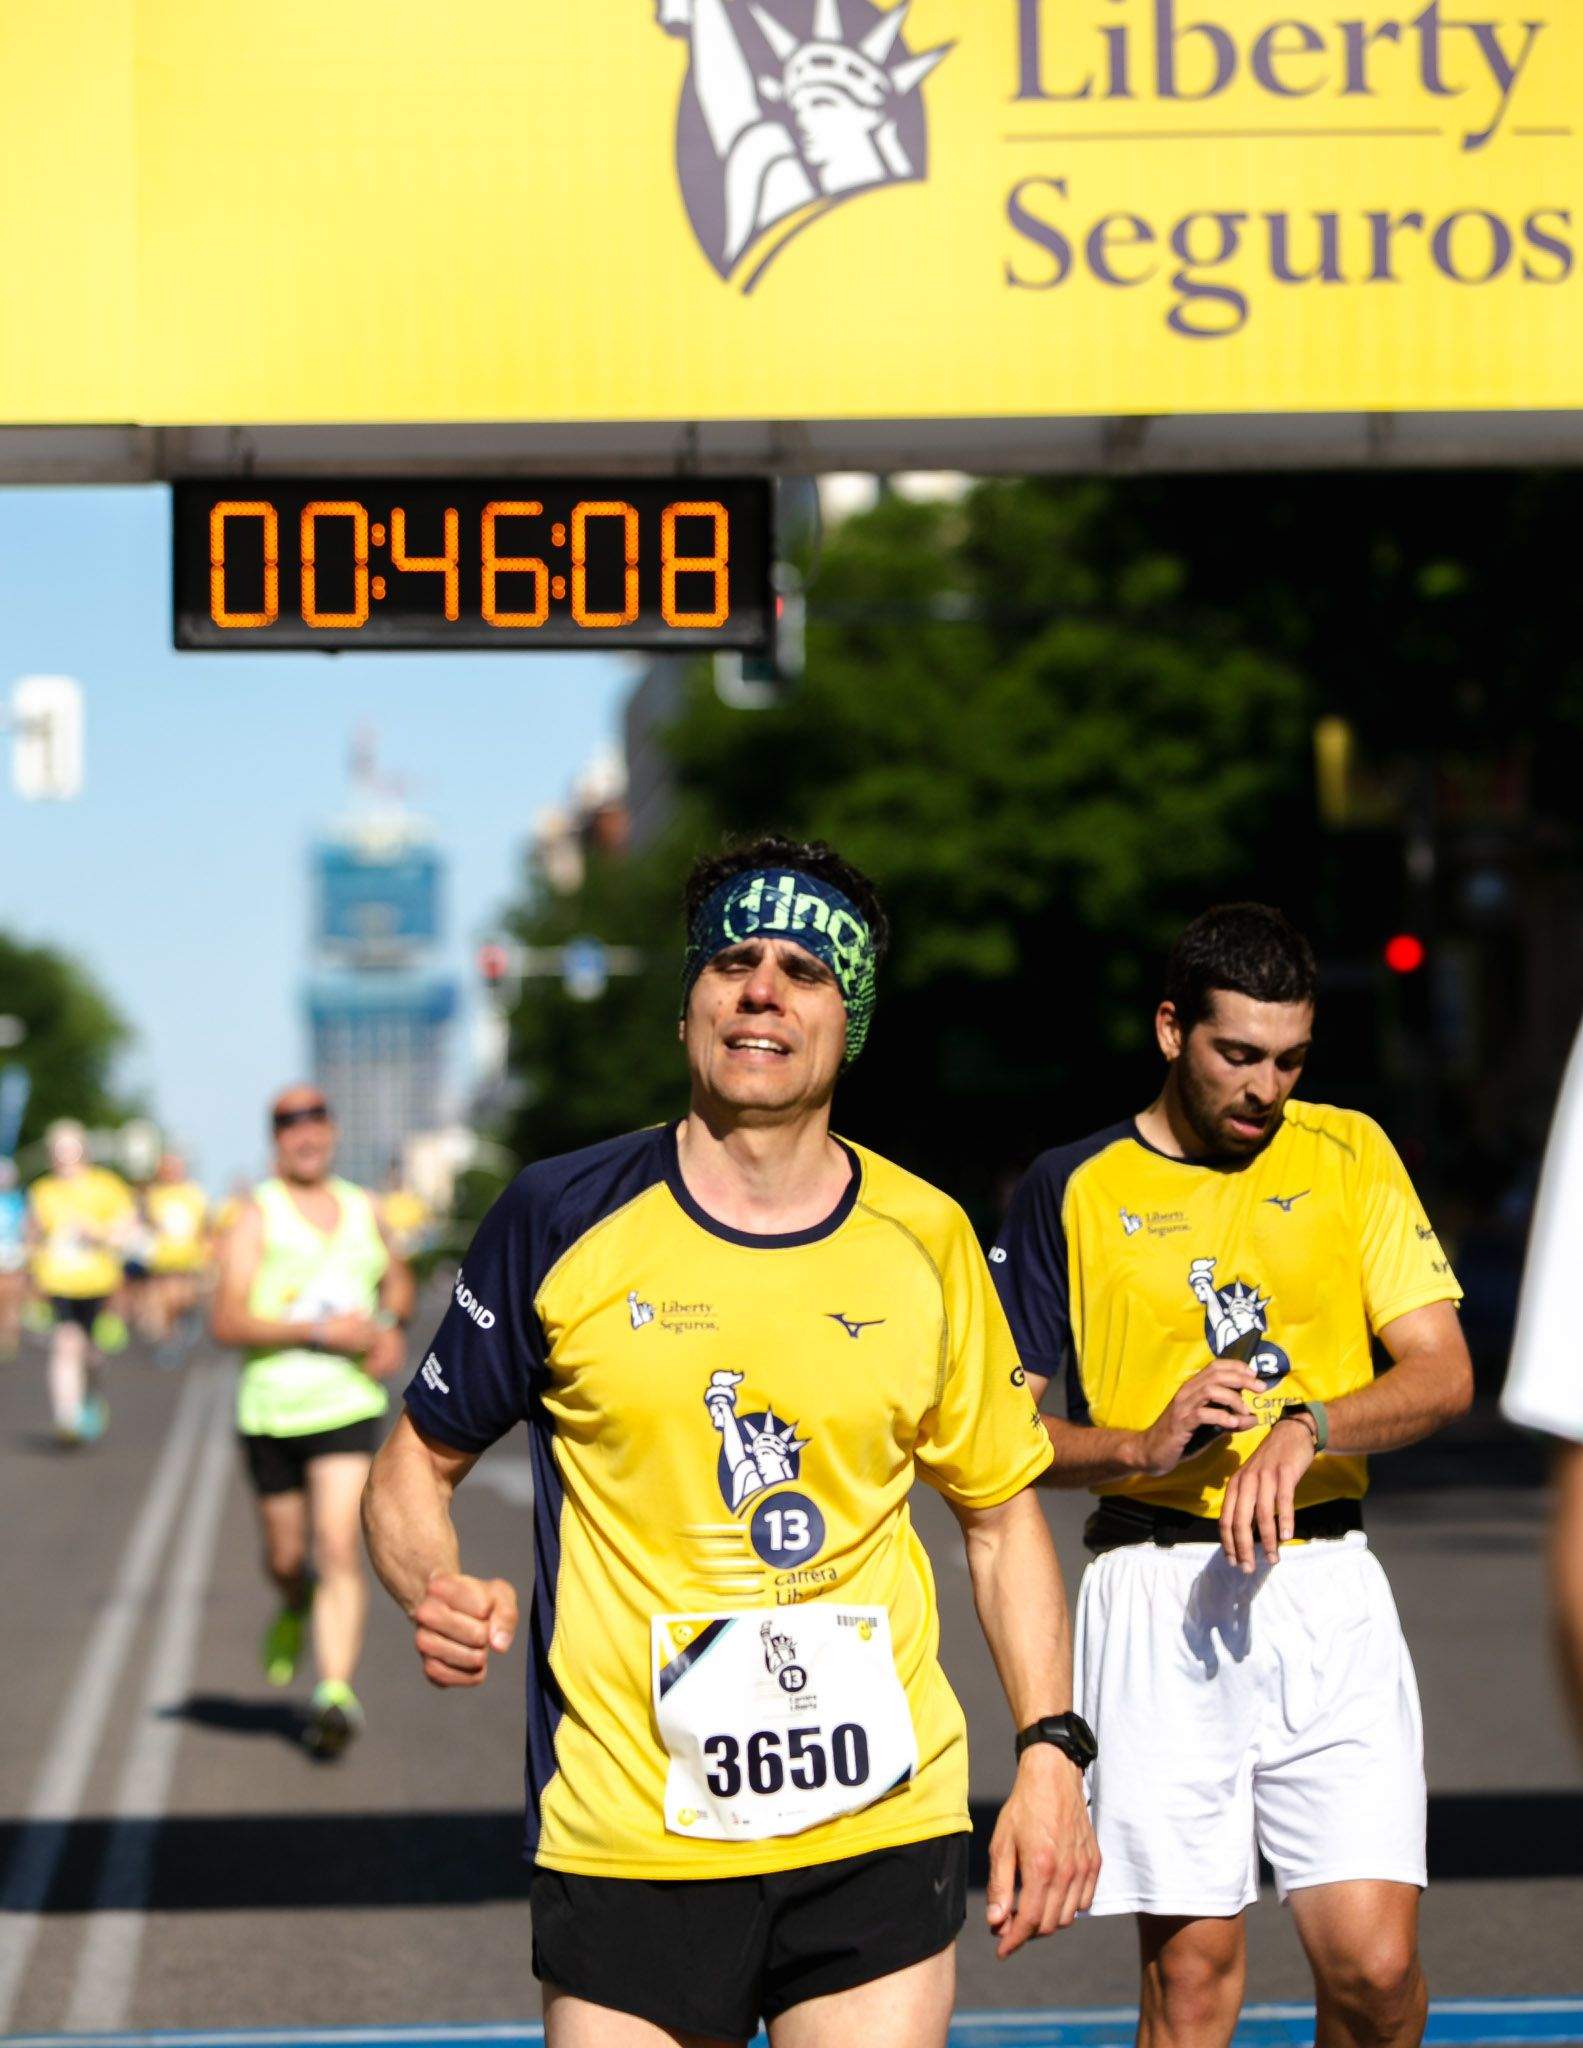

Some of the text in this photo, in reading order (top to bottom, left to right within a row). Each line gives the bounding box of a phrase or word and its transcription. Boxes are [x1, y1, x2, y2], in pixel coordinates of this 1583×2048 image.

[1007, 0, 1543, 152] Liberty
[1003, 175, 1575, 339] Seguros
[209, 501, 729, 628] 00:46:08
[661, 1300, 714, 1317] Liberty
[764, 1509, 811, 1551] 13
[704, 1722, 870, 1798] 3650
